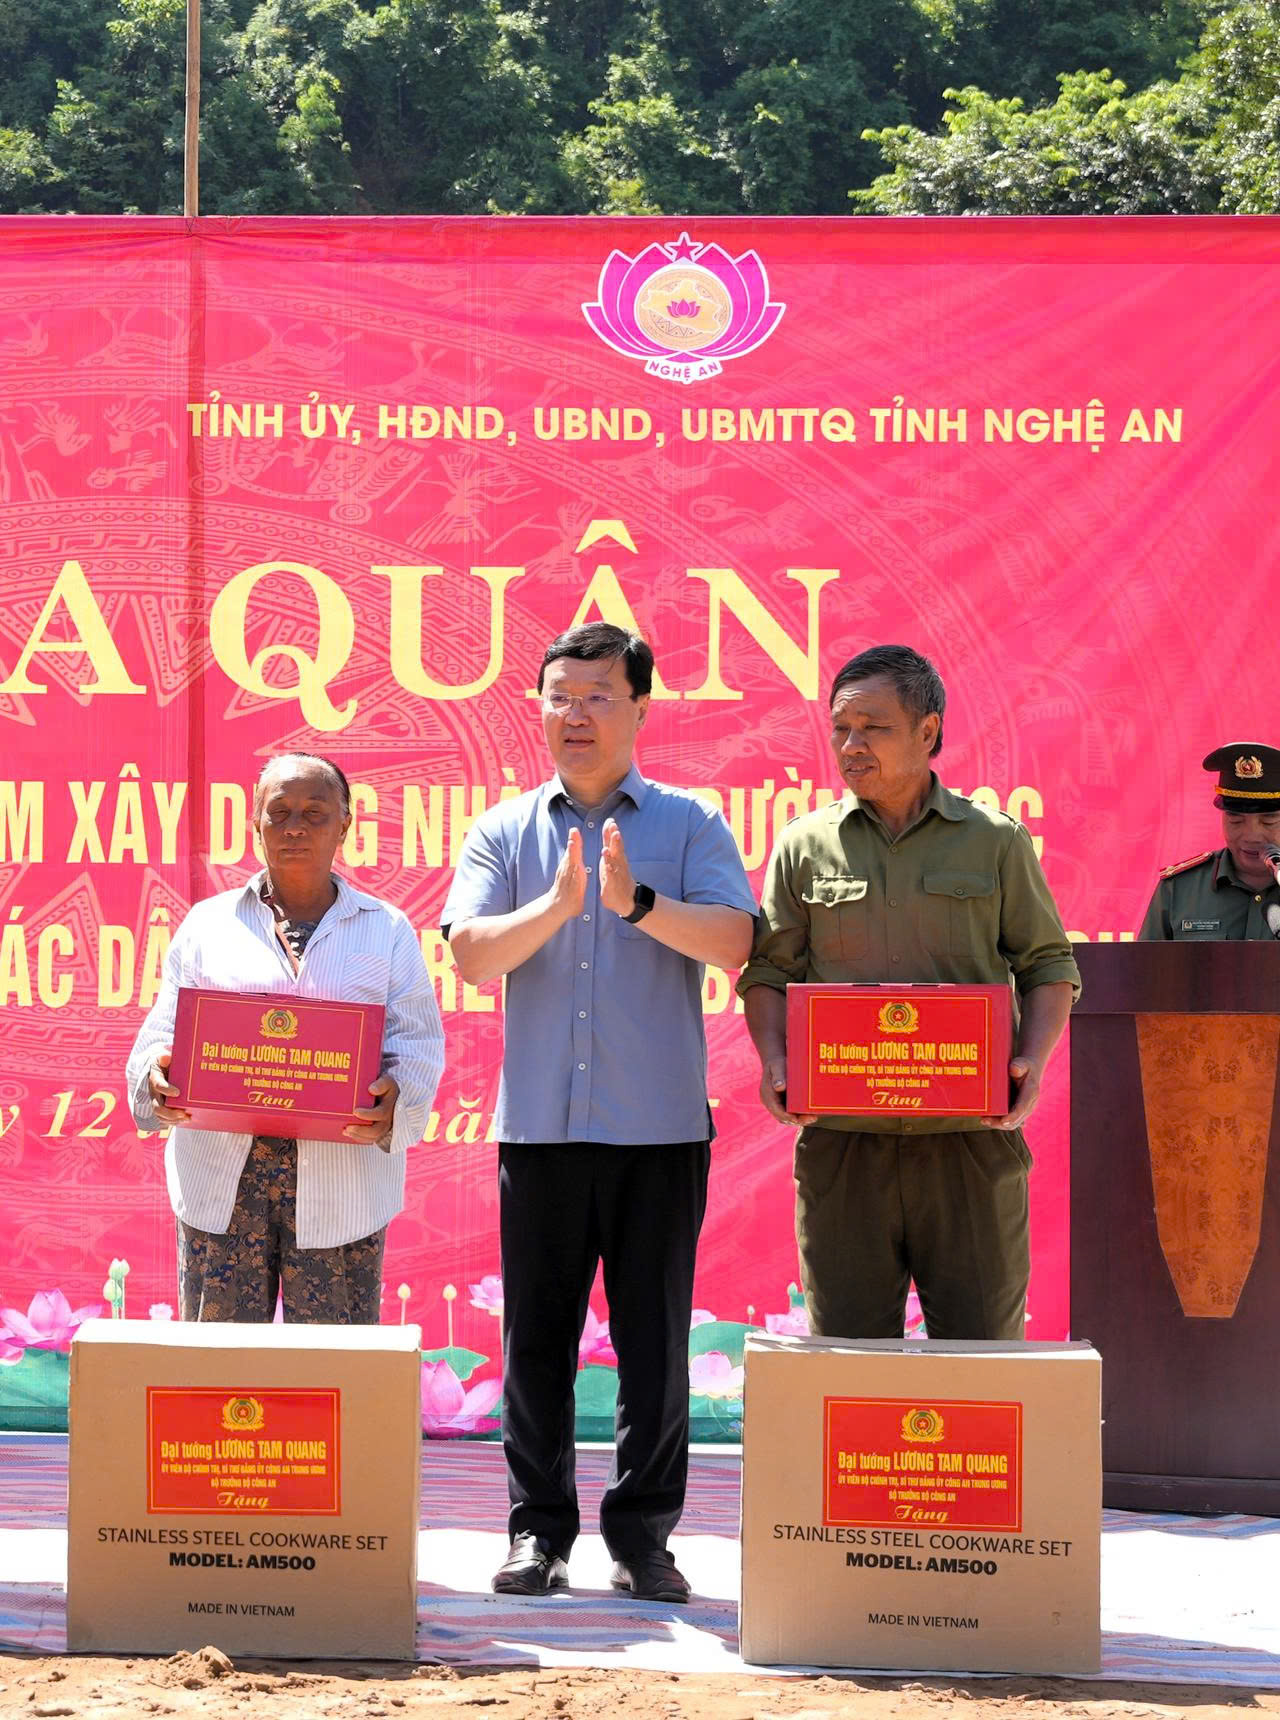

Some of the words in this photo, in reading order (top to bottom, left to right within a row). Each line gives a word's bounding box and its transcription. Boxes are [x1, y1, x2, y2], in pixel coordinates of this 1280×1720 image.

[649, 361, 690, 381] NGHỆ
[698, 362, 718, 376] AN
[186, 390, 284, 438] TỈNH
[299, 390, 361, 446] ỦY,
[378, 404, 518, 447] HĐND,
[533, 407, 664, 448] UBND,
[681, 407, 855, 445] UBMTTQ
[870, 395, 967, 444] TỈNH
[985, 399, 1105, 453] NGHỆ
[1119, 409, 1183, 444] AN
[208, 518, 841, 734] QUÂN
[66, 763, 188, 865] XÂY
[202, 1042, 218, 1060] Đại
[251, 1045, 286, 1064] LƯƠNG
[289, 1048, 311, 1065] TAM
[314, 1050, 350, 1069] QUANG
[820, 1043, 836, 1063] Đại
[872, 1041, 908, 1060] LƯƠNG
[912, 1043, 935, 1060] TAM
[939, 1043, 977, 1061] QUANG
[248, 1091, 294, 1108] Tặng
[872, 1091, 923, 1107] Tặng
[40, 1089, 116, 1138] 12
[161, 1441, 179, 1461] Đại
[215, 1439, 254, 1458] LƯƠNG
[258, 1441, 282, 1458] TAM
[286, 1441, 326, 1460] QUANG
[839, 1451, 856, 1472] Đại
[894, 1450, 933, 1471] LƯƠNG
[938, 1453, 962, 1472] TAM
[966, 1455, 1007, 1474] QUANG
[962, 1478, 970, 1487] AN
[217, 1492, 269, 1509] Tặng
[948, 1492, 955, 1502] AN
[895, 1505, 949, 1522] Tặng
[98, 1528, 188, 1544] STAINLESS
[193, 1531, 244, 1546] STEEL
[249, 1532, 351, 1549] COOKWARE
[356, 1536, 388, 1550] SET
[773, 1525, 866, 1544] STAINLESS
[870, 1530, 924, 1549] STEEL
[930, 1534, 1034, 1554] COOKWARE
[1039, 1540, 1072, 1556] SET
[169, 1552, 243, 1569] MODEL:
[246, 1555, 316, 1570] AM500
[846, 1552, 922, 1571] MODEL:
[925, 1557, 997, 1575] AM500
[188, 1602, 222, 1614] MADE
[226, 1604, 238, 1614] IN
[241, 1604, 295, 1617] VIETNAM
[868, 1613, 904, 1625] MADE
[907, 1615, 919, 1625] IN
[922, 1615, 979, 1629] VIETNAM
